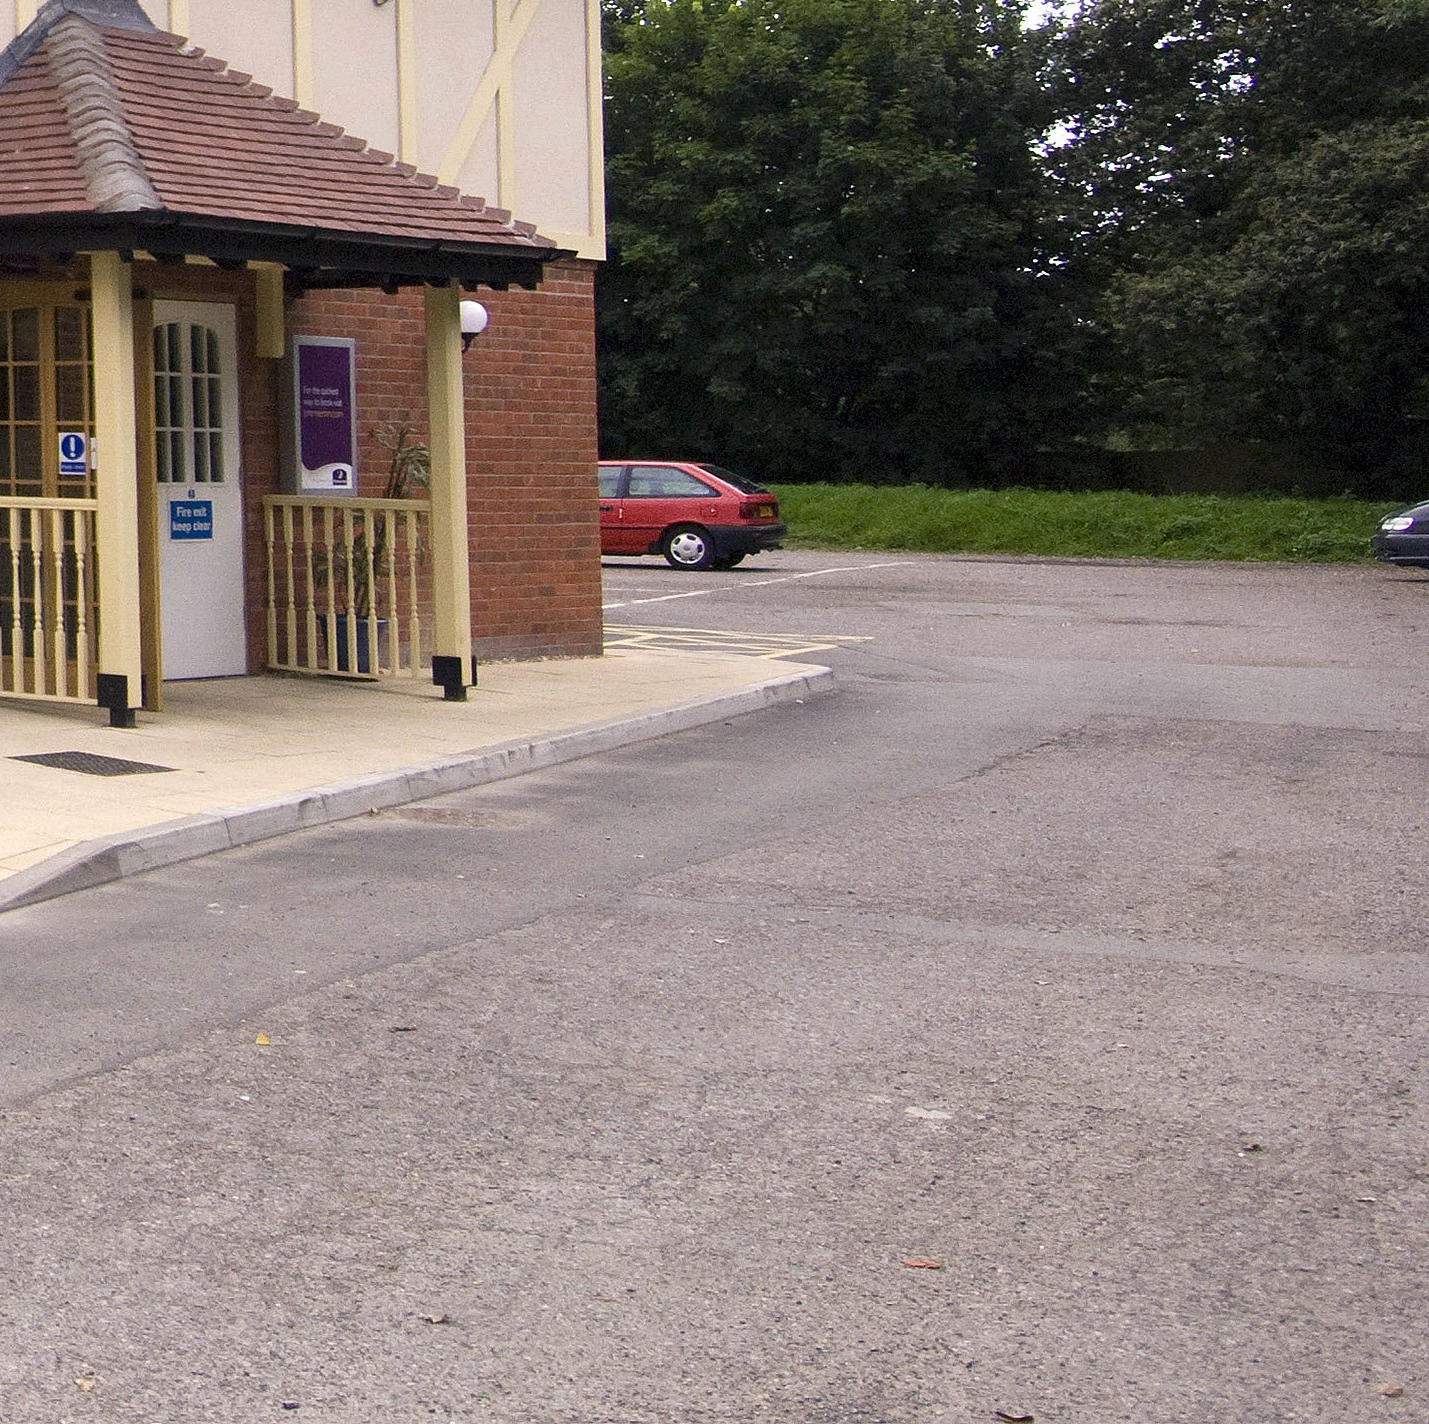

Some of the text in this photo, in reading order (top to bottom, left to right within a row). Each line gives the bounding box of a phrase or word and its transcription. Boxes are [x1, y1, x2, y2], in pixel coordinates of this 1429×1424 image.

[176, 506, 207, 517] Fire exit
[172, 520, 211, 533] keep clear
